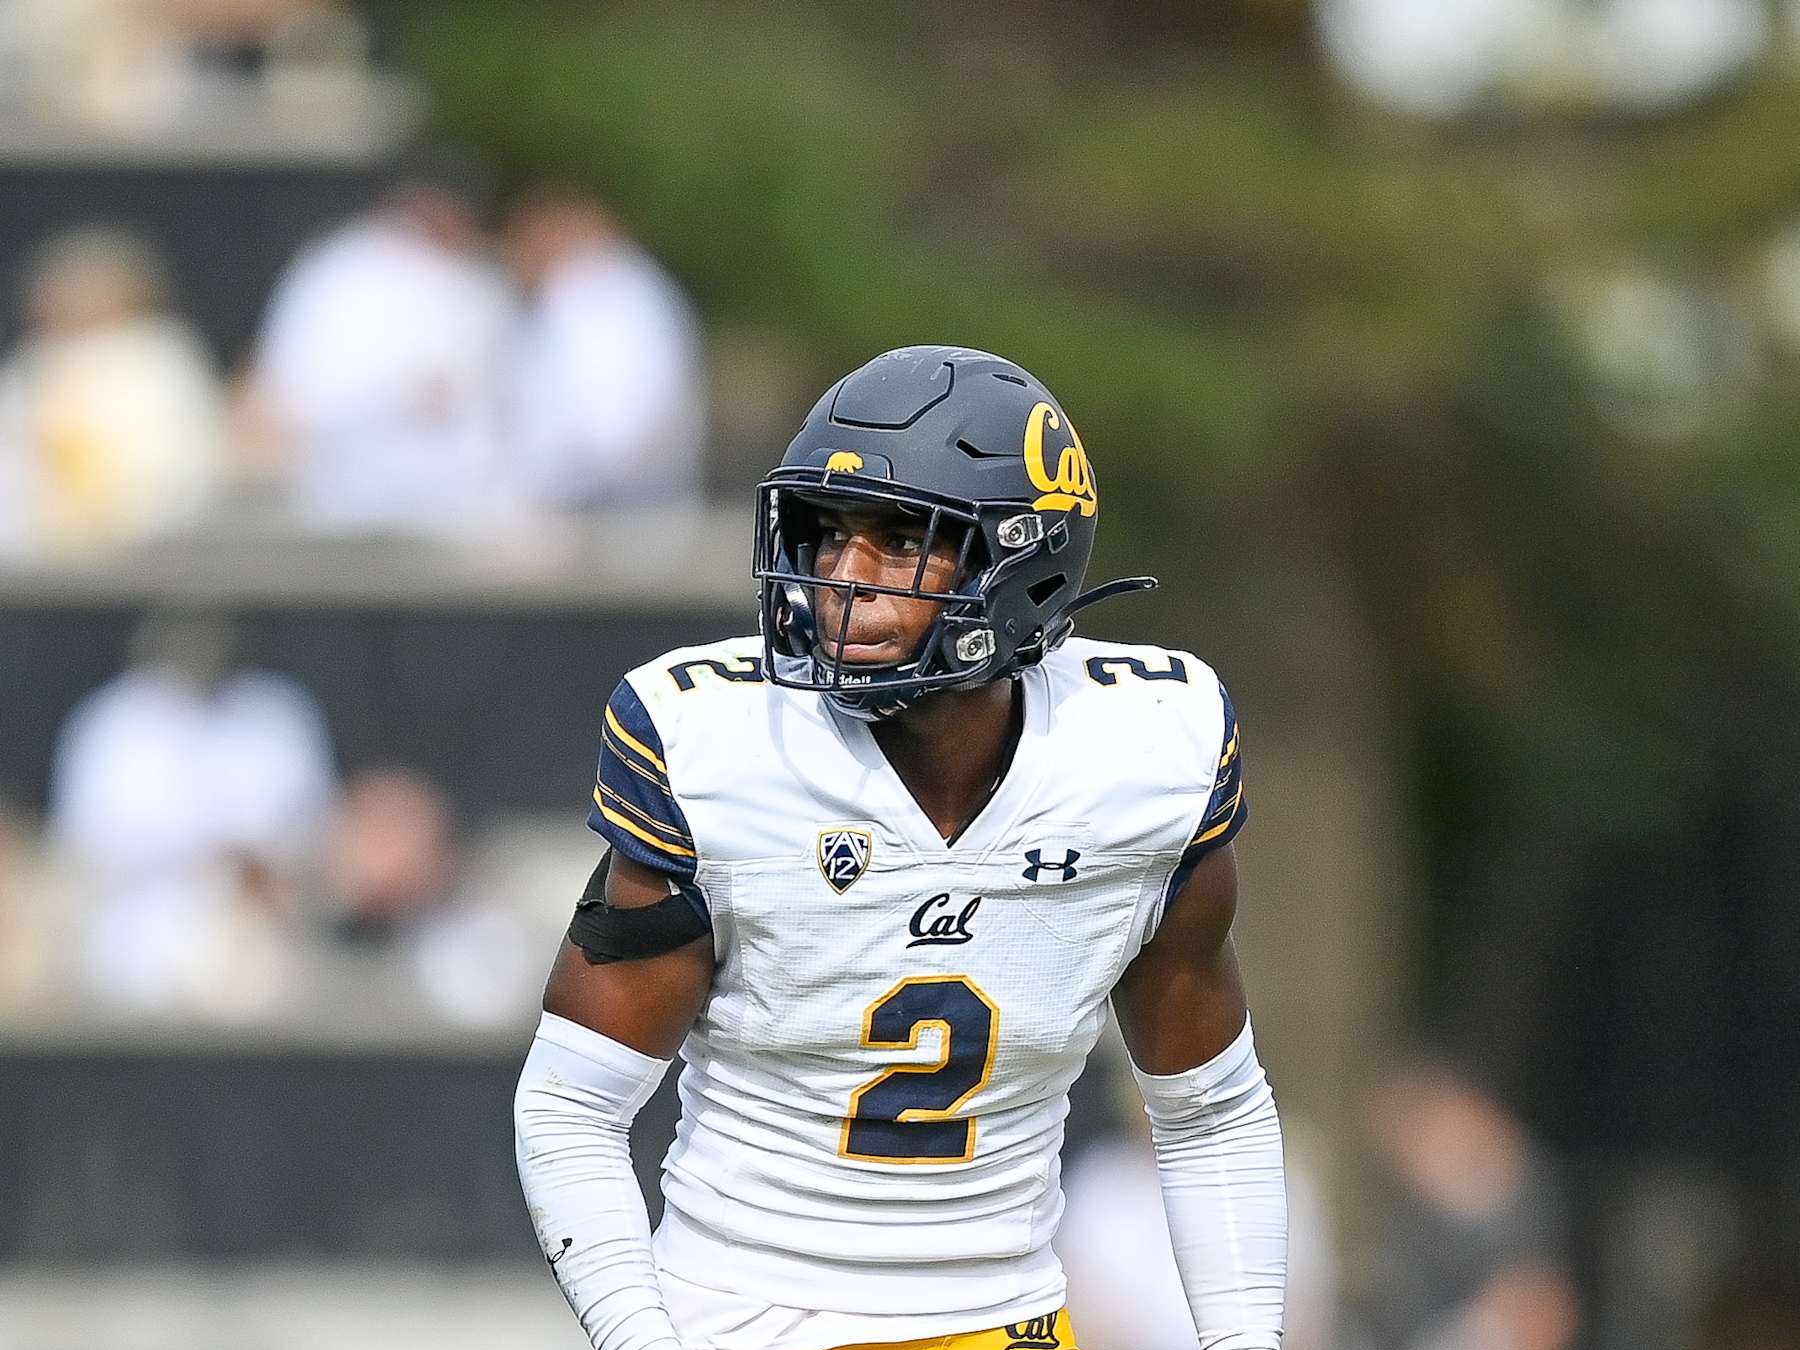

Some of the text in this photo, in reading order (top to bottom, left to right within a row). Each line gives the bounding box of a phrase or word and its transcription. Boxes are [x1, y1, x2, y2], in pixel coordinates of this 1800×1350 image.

[1023, 401, 1097, 518] Cal
[826, 670, 871, 685] Rddell
[1085, 655, 1189, 686] 2
[820, 831, 868, 868] PAC
[829, 856, 856, 880] 12
[906, 892, 982, 949] Cal
[837, 973, 1000, 1164] 2
